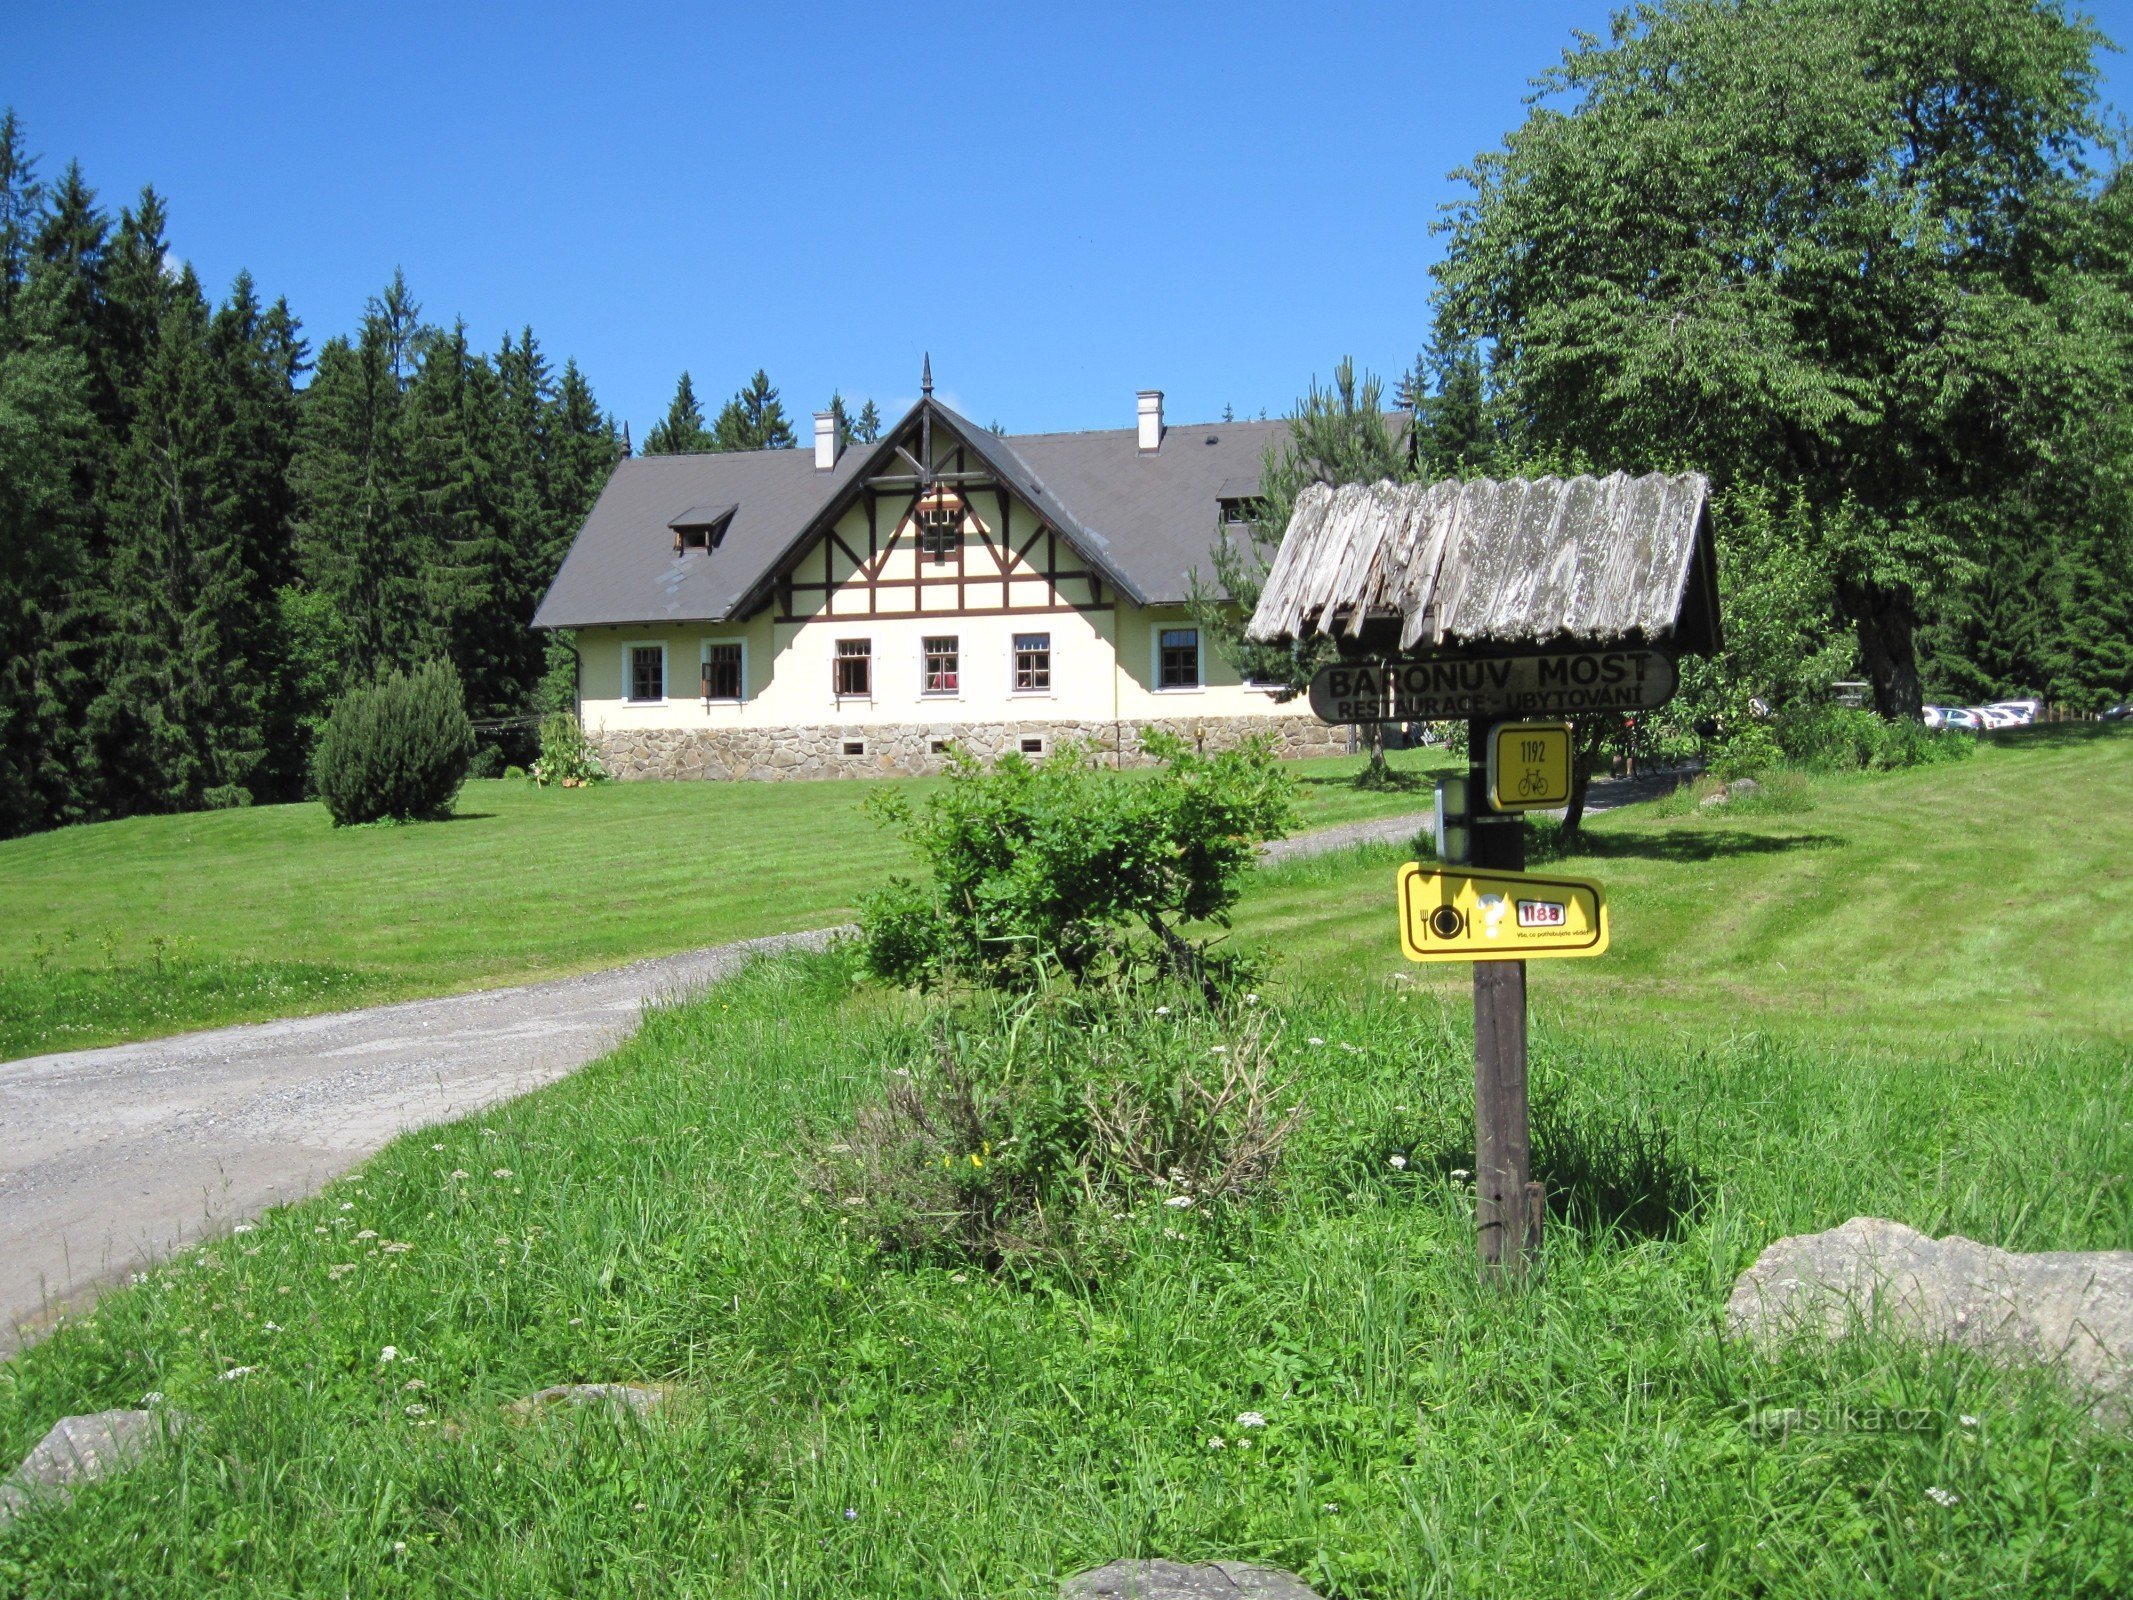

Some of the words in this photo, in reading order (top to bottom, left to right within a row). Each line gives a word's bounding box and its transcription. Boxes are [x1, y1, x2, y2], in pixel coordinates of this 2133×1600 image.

[1538, 652, 1652, 687] MOST
[1338, 694, 1485, 719] RESTAURACE
[1506, 682, 1643, 710] UBYTOVÁNÍ
[1520, 740, 1546, 763] 1192
[1523, 905, 1560, 922] 1188
